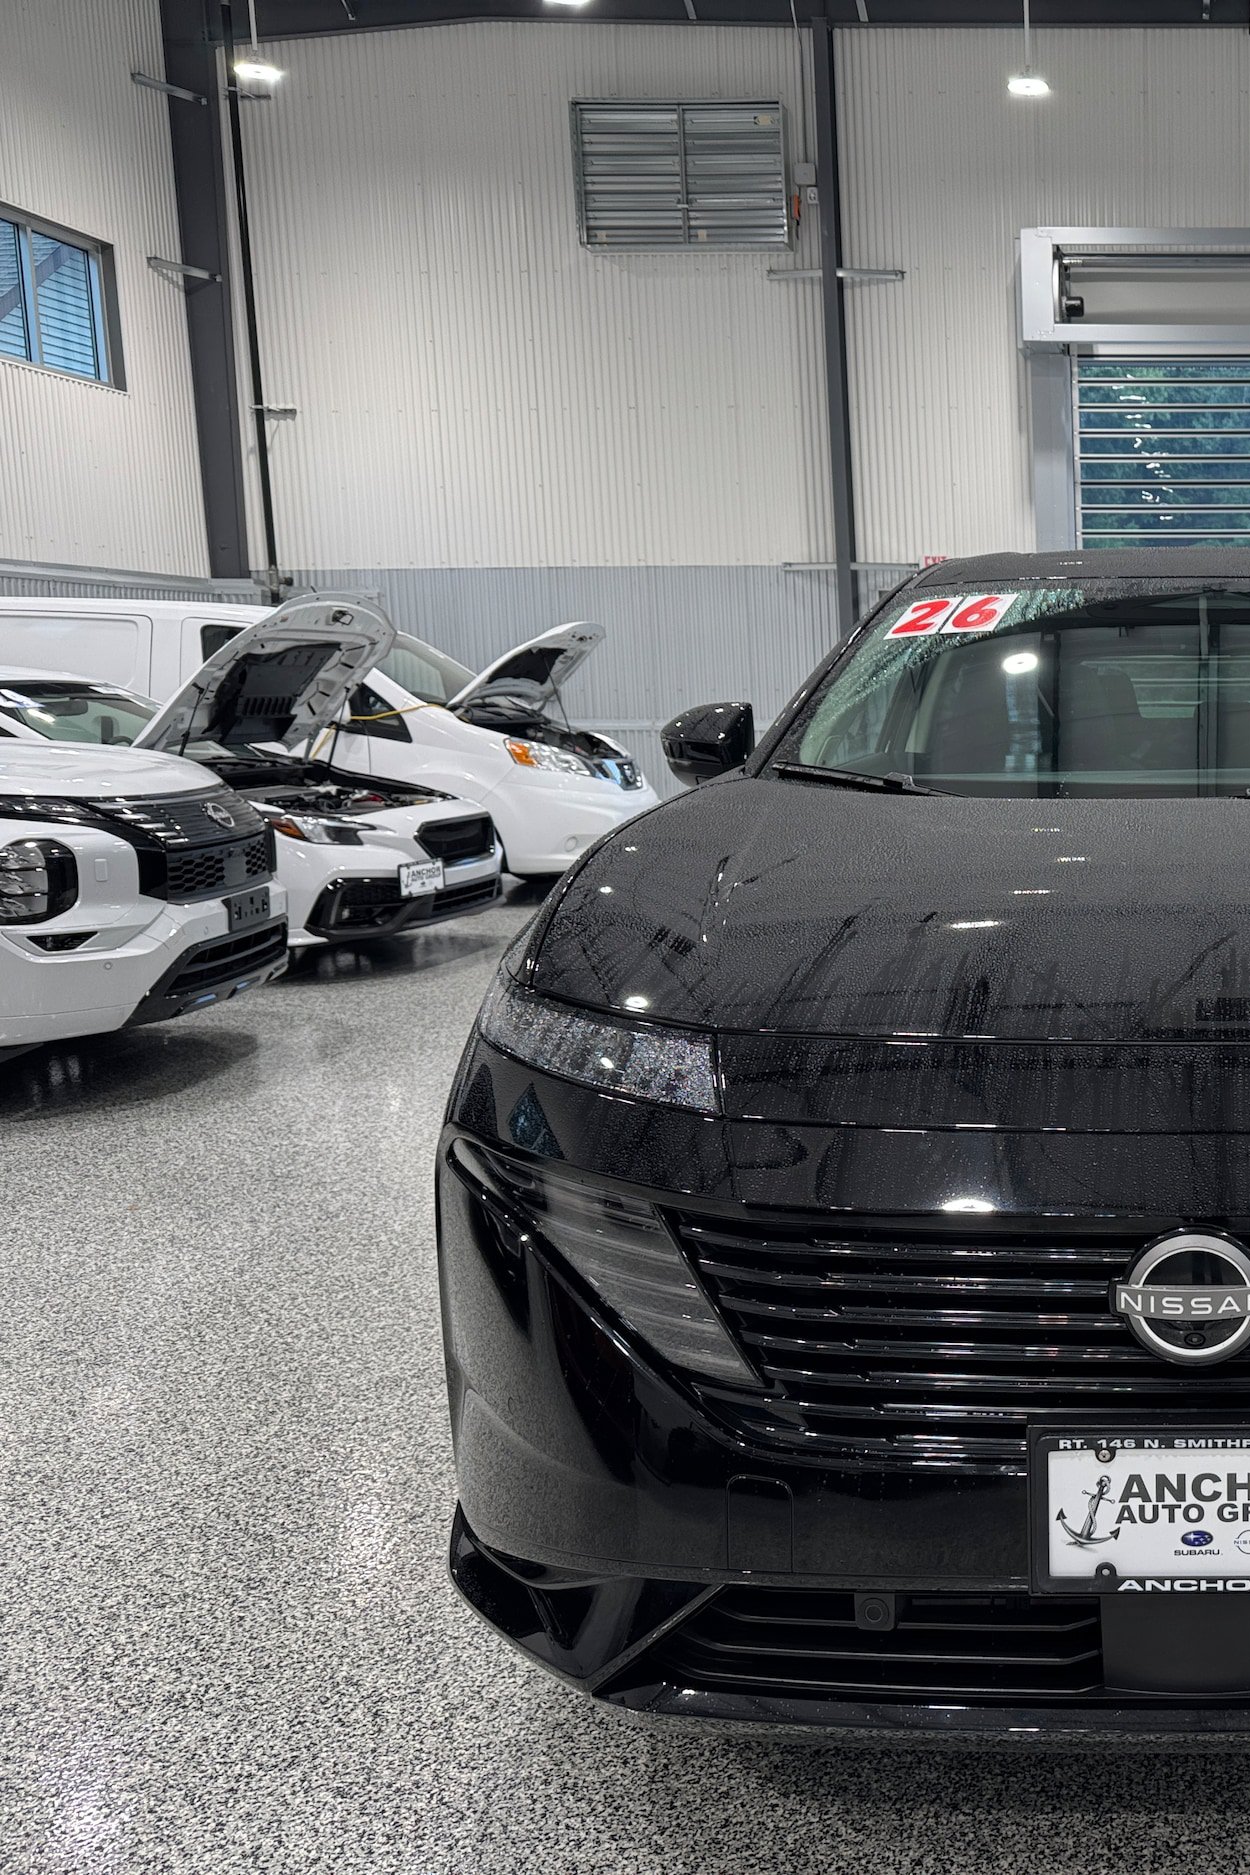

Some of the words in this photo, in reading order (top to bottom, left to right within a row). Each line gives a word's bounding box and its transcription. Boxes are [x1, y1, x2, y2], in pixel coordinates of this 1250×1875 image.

[1058, 1439, 1087, 1449] RT.
[1097, 1439, 1136, 1448] 146
[1143, 1439, 1166, 1448] N.
[1115, 1503, 1205, 1524] AUTO
